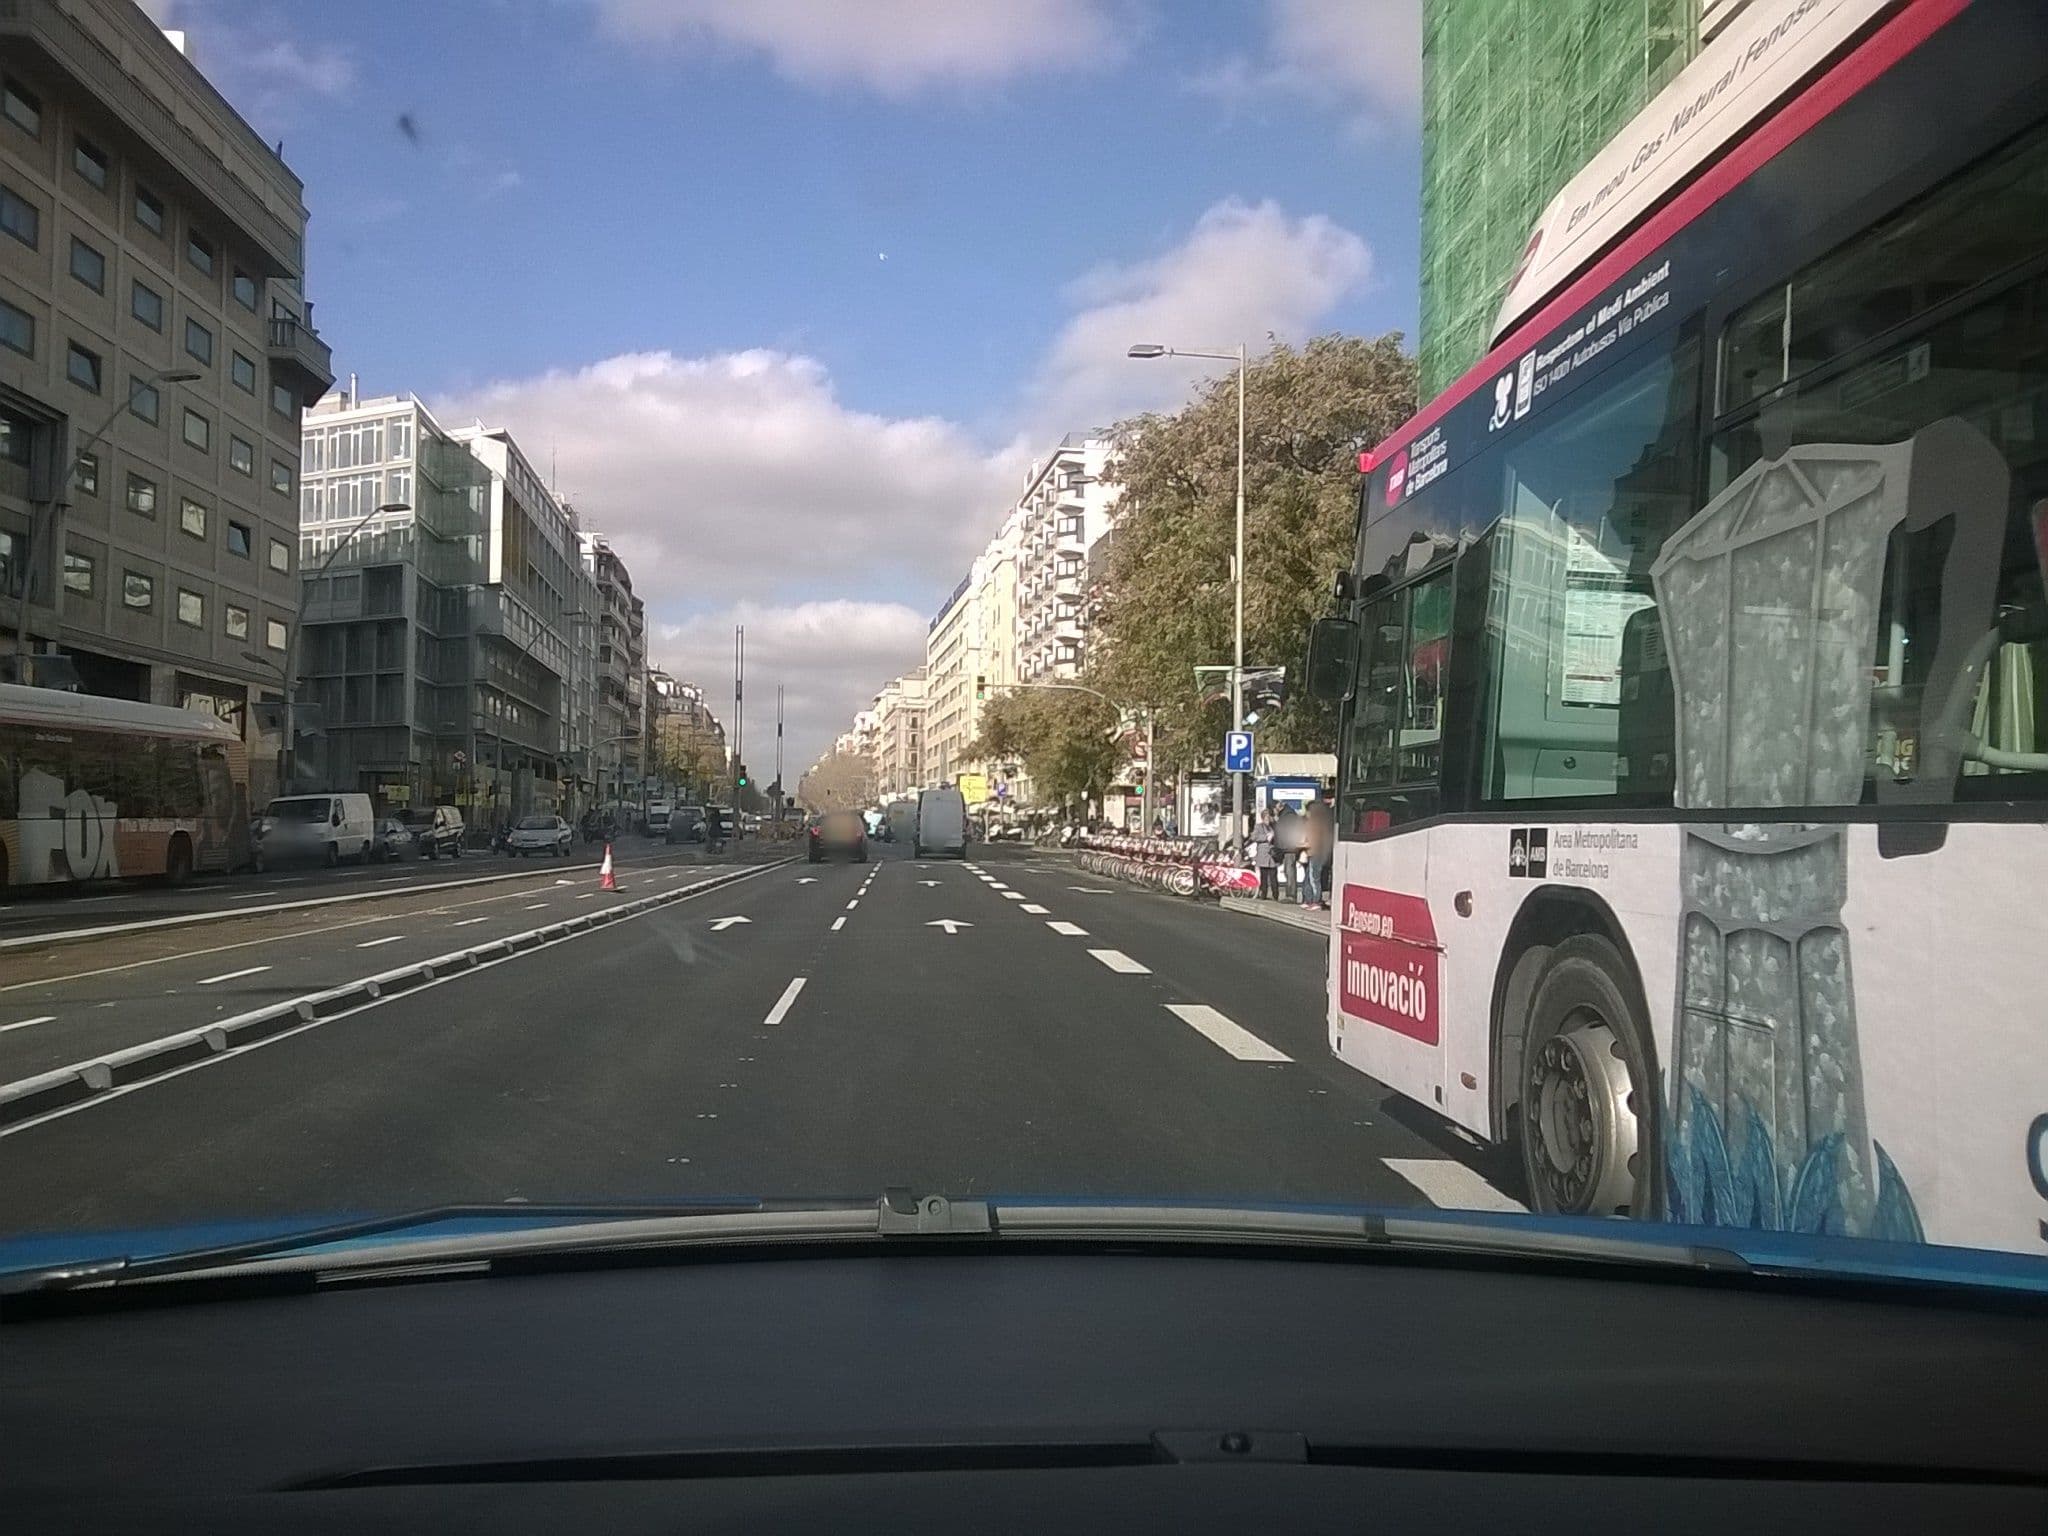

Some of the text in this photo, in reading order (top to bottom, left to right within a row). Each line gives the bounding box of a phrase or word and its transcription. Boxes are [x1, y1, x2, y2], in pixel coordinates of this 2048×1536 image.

[1566, 201, 1590, 233] Em
[1591, 167, 1628, 209] mou
[1631, 133, 1664, 173] Gas
[1666, 56, 1741, 143] Natural
[1586, 315, 1596, 335] el
[1597, 294, 1623, 327] Medi
[1623, 260, 1670, 308] Ambient
[1231, 735, 1248, 756] P
[16, 766, 119, 884] FOX
[1574, 829, 1638, 853] Metropolitana
[1553, 859, 1609, 879] de Barcelona
[1381, 915, 1393, 939] en
[1346, 945, 1426, 1022] innovació
